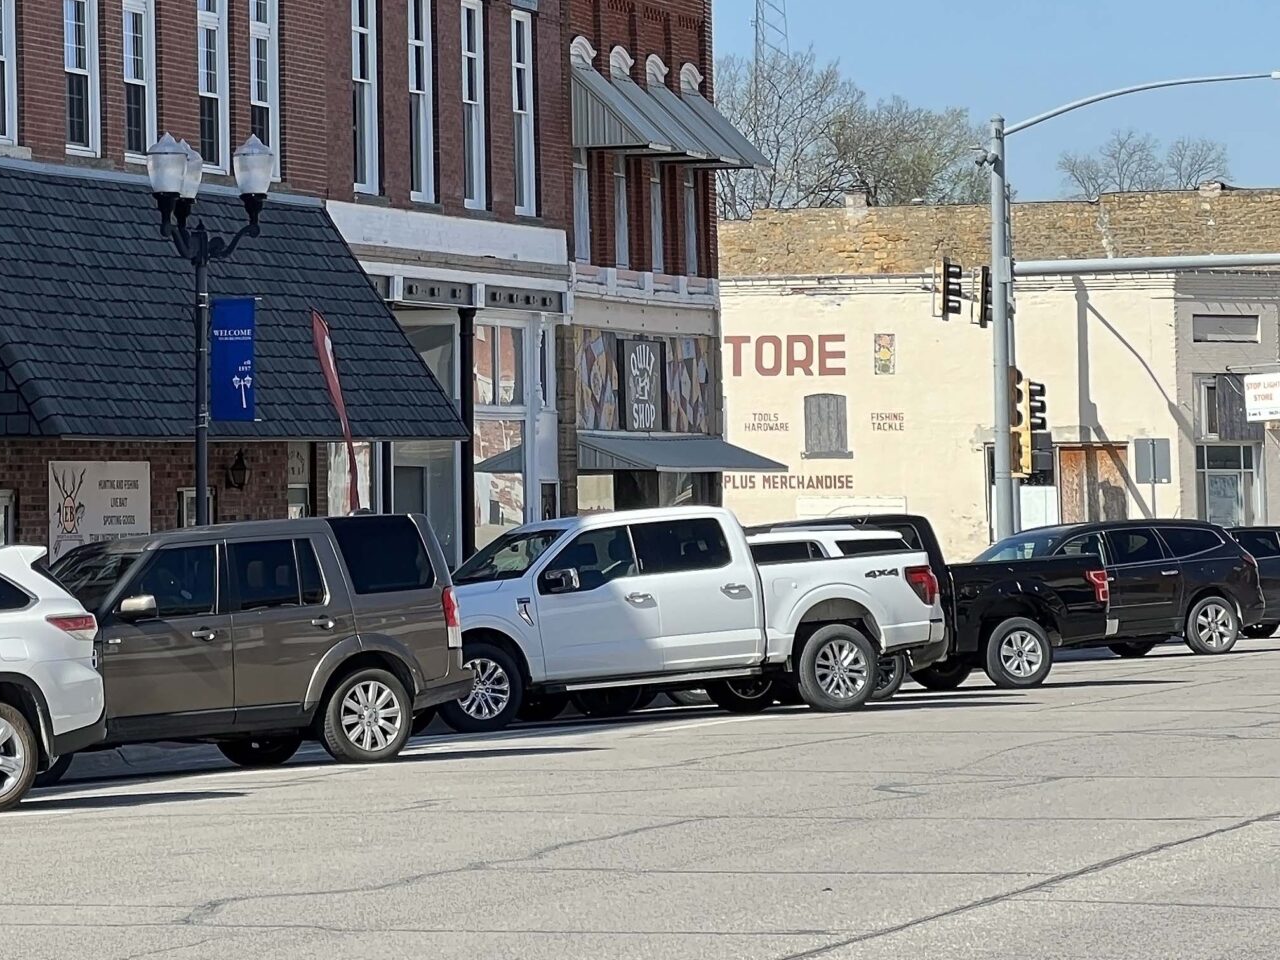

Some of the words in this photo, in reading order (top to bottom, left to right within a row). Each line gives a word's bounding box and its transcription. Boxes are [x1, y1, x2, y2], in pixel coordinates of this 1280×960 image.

[630, 344, 656, 377] QUILT
[632, 403, 656, 429] SHOP
[752, 413, 779, 422] TOOLS
[871, 412, 904, 421] FISHING
[744, 423, 789, 431] HARDWARE
[872, 423, 904, 431] TACKLE
[762, 475, 854, 490] MERCHANDISE
